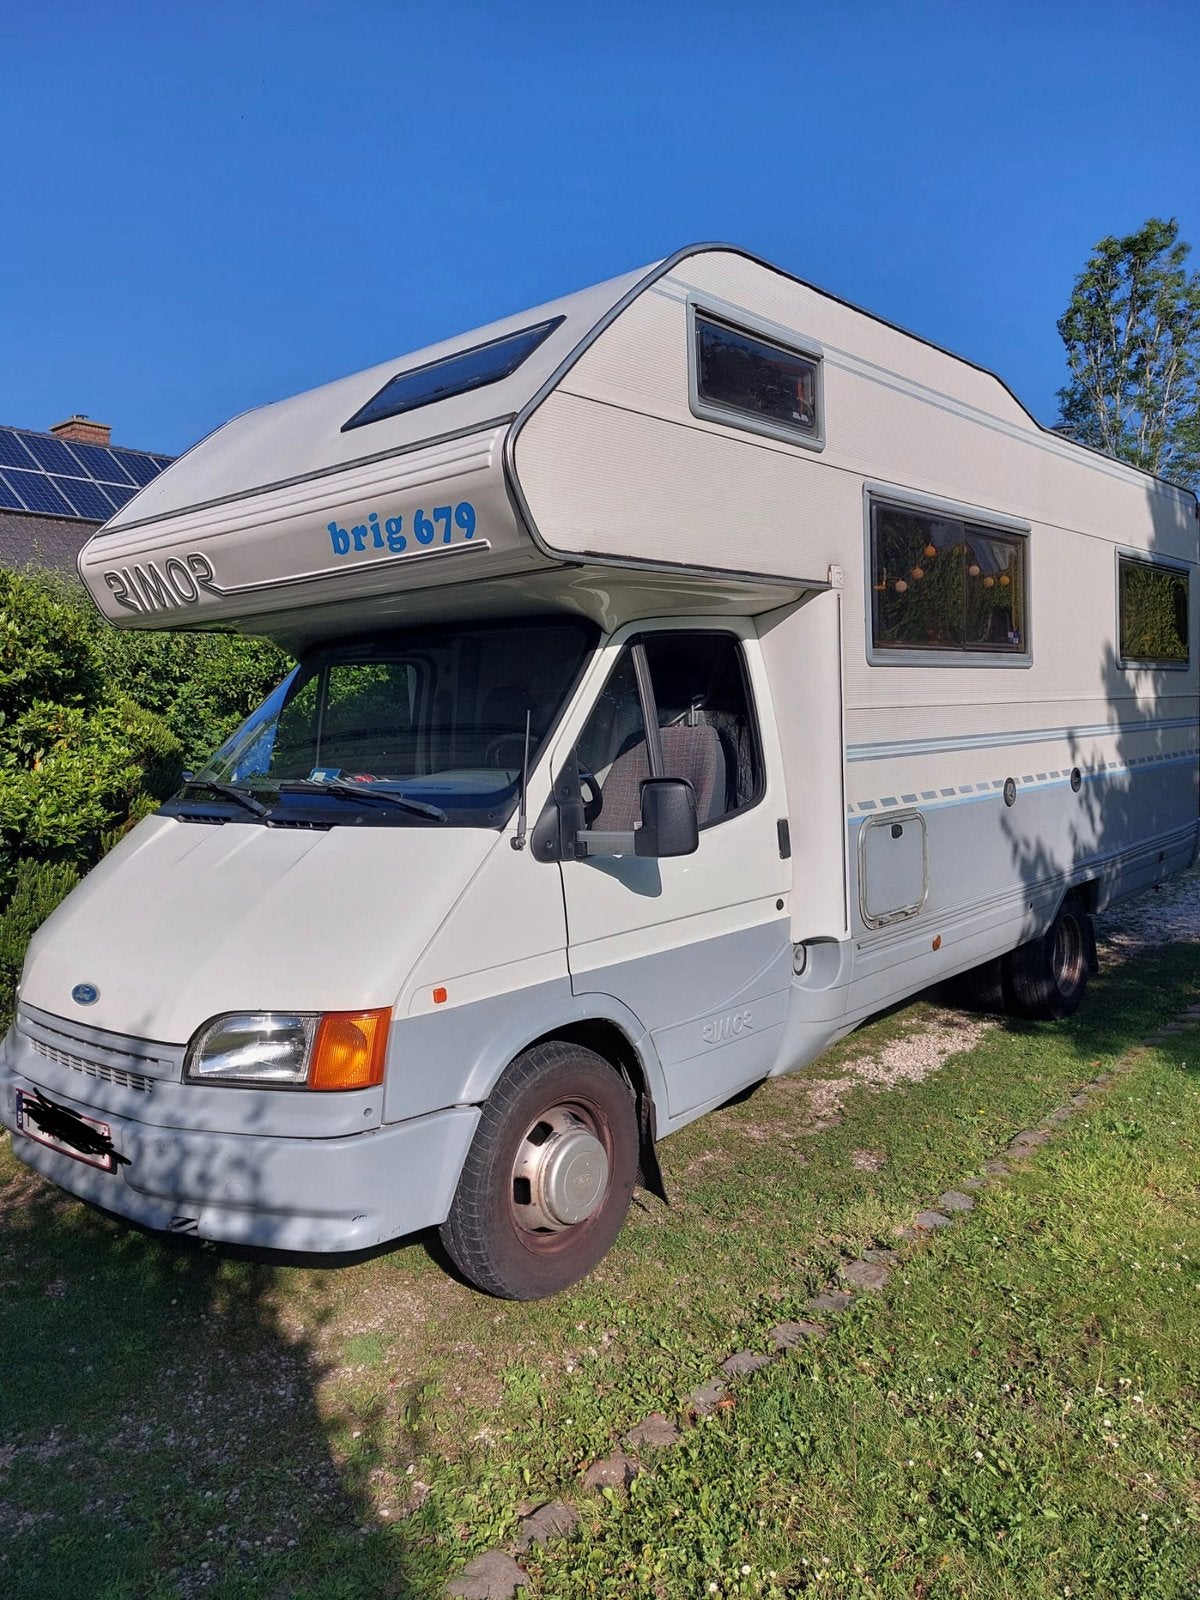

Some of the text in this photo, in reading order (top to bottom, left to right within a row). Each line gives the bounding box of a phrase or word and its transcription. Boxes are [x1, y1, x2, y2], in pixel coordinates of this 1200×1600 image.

[327, 501, 476, 555] brig 679
[103, 551, 219, 614] RIMOR
[702, 1009, 753, 1044] RIMOR
